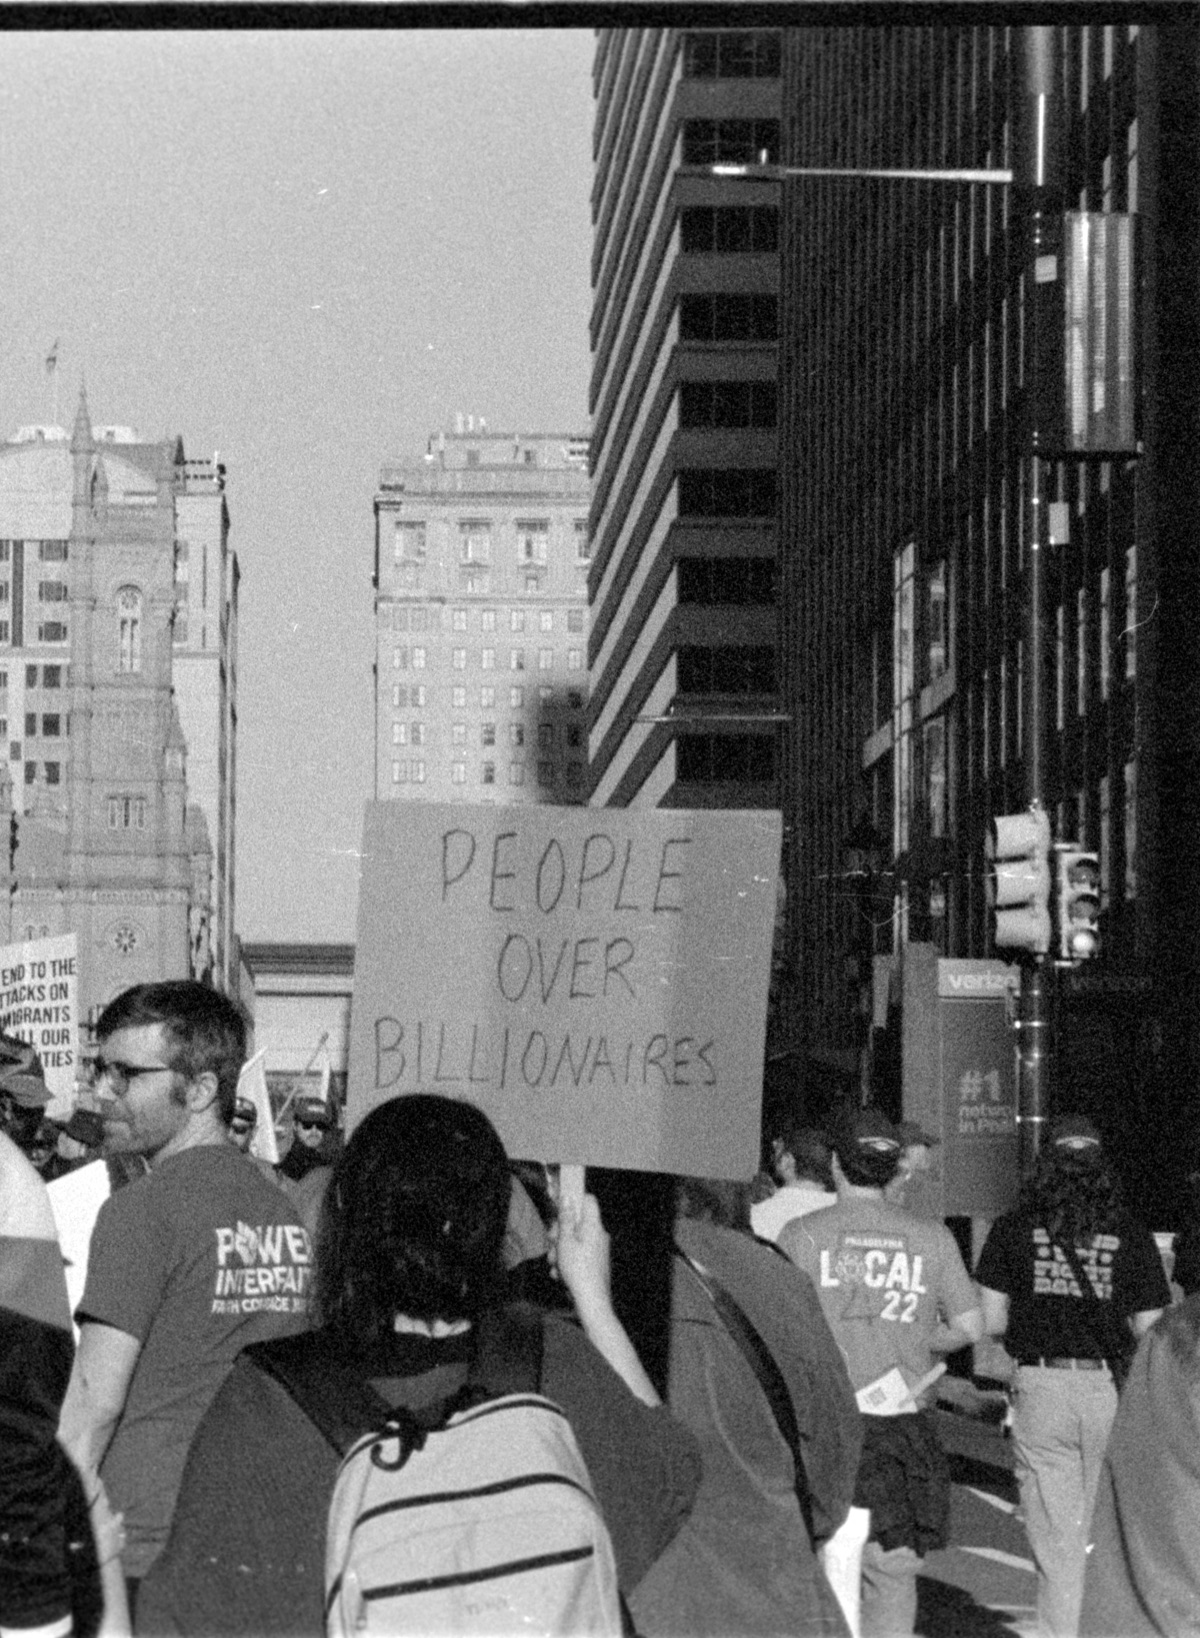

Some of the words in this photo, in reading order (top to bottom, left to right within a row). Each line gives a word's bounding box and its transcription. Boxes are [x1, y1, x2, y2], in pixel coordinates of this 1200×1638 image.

[442, 829, 693, 914] PEOPLE
[2, 964, 25, 986] END
[30, 961, 46, 979] TO
[49, 957, 76, 977] THE
[497, 933, 636, 1004] OVER
[950, 969, 1019, 989] verizo
[50, 982, 69, 1000] ON
[0, 1005, 71, 1027] MIGRANTS
[41, 1029, 70, 1045] OUR
[374, 1016, 717, 1090] BILLIONAIRES
[880, 1290, 918, 1323] 22
